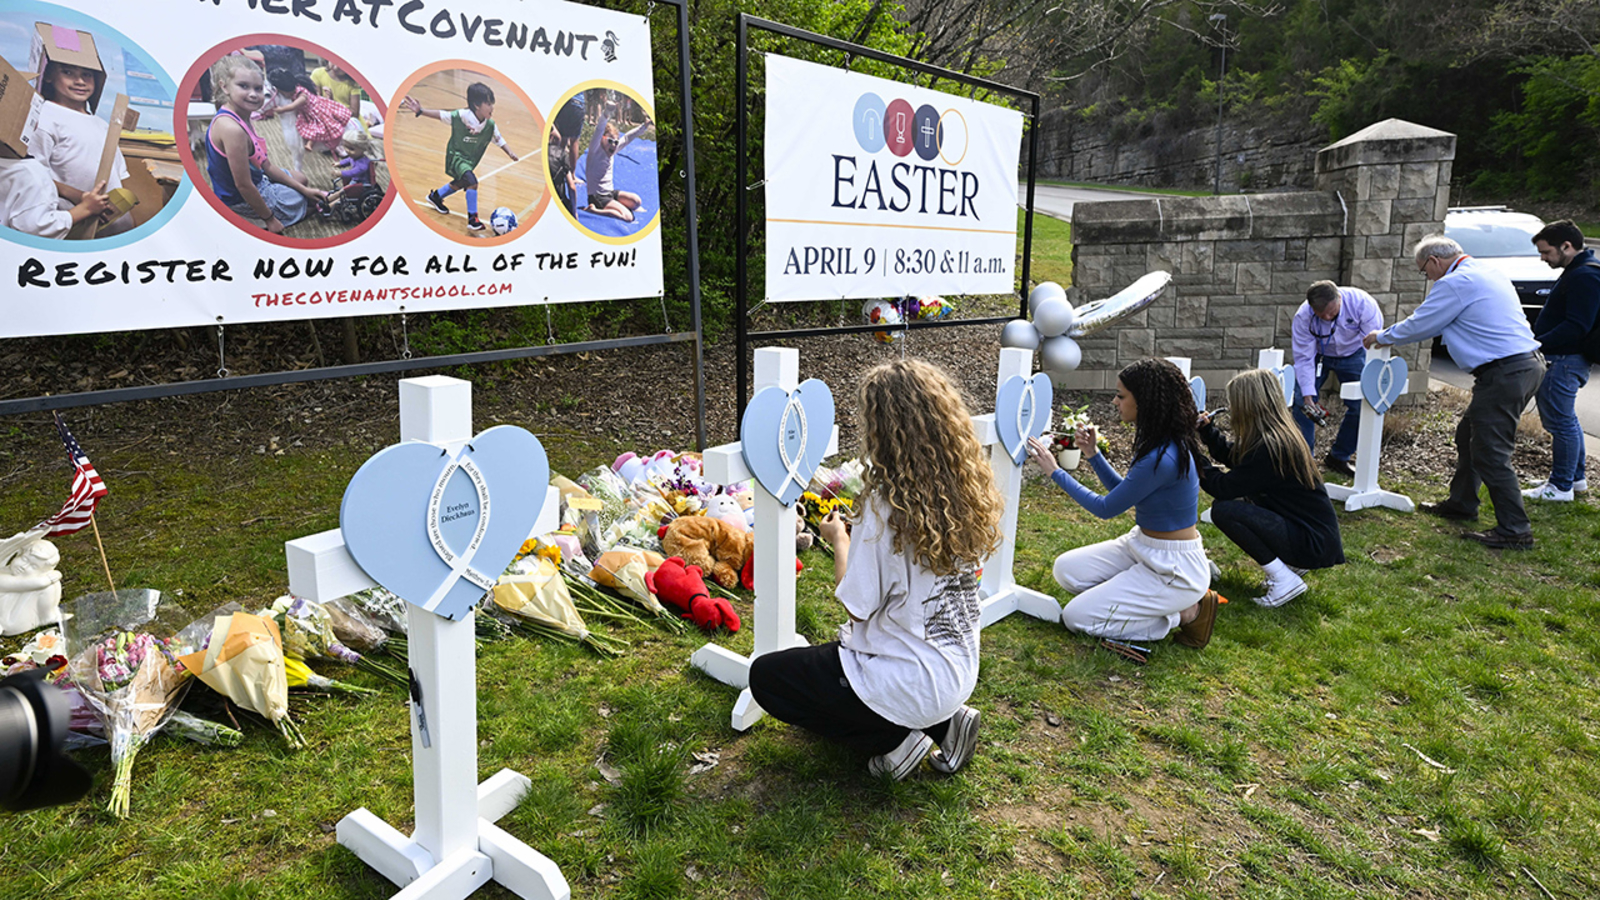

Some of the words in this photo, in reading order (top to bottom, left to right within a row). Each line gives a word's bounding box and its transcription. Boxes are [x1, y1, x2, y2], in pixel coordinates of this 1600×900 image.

[397, 0, 599, 61] COVENANT
[830, 153, 981, 222] EASTER
[17, 257, 234, 288] REGISTER
[252, 257, 334, 280] NOW
[350, 255, 410, 277] FOR
[425, 254, 478, 274] ALL
[492, 253, 526, 272] OF
[535, 252, 579, 271] THE
[589, 248, 637, 269] FUN!
[783, 246, 858, 277] APRIL
[863, 247, 876, 275] 9
[894, 247, 936, 275] 8:30
[940, 249, 955, 275] &
[957, 250, 970, 274] 11
[973, 256, 1006, 274] a.m.
[251, 283, 513, 308] THECOVENANTSCHOOL.COM
[441, 509, 475, 524] Dieckhaus
[446, 502, 470, 513] Evelyn
